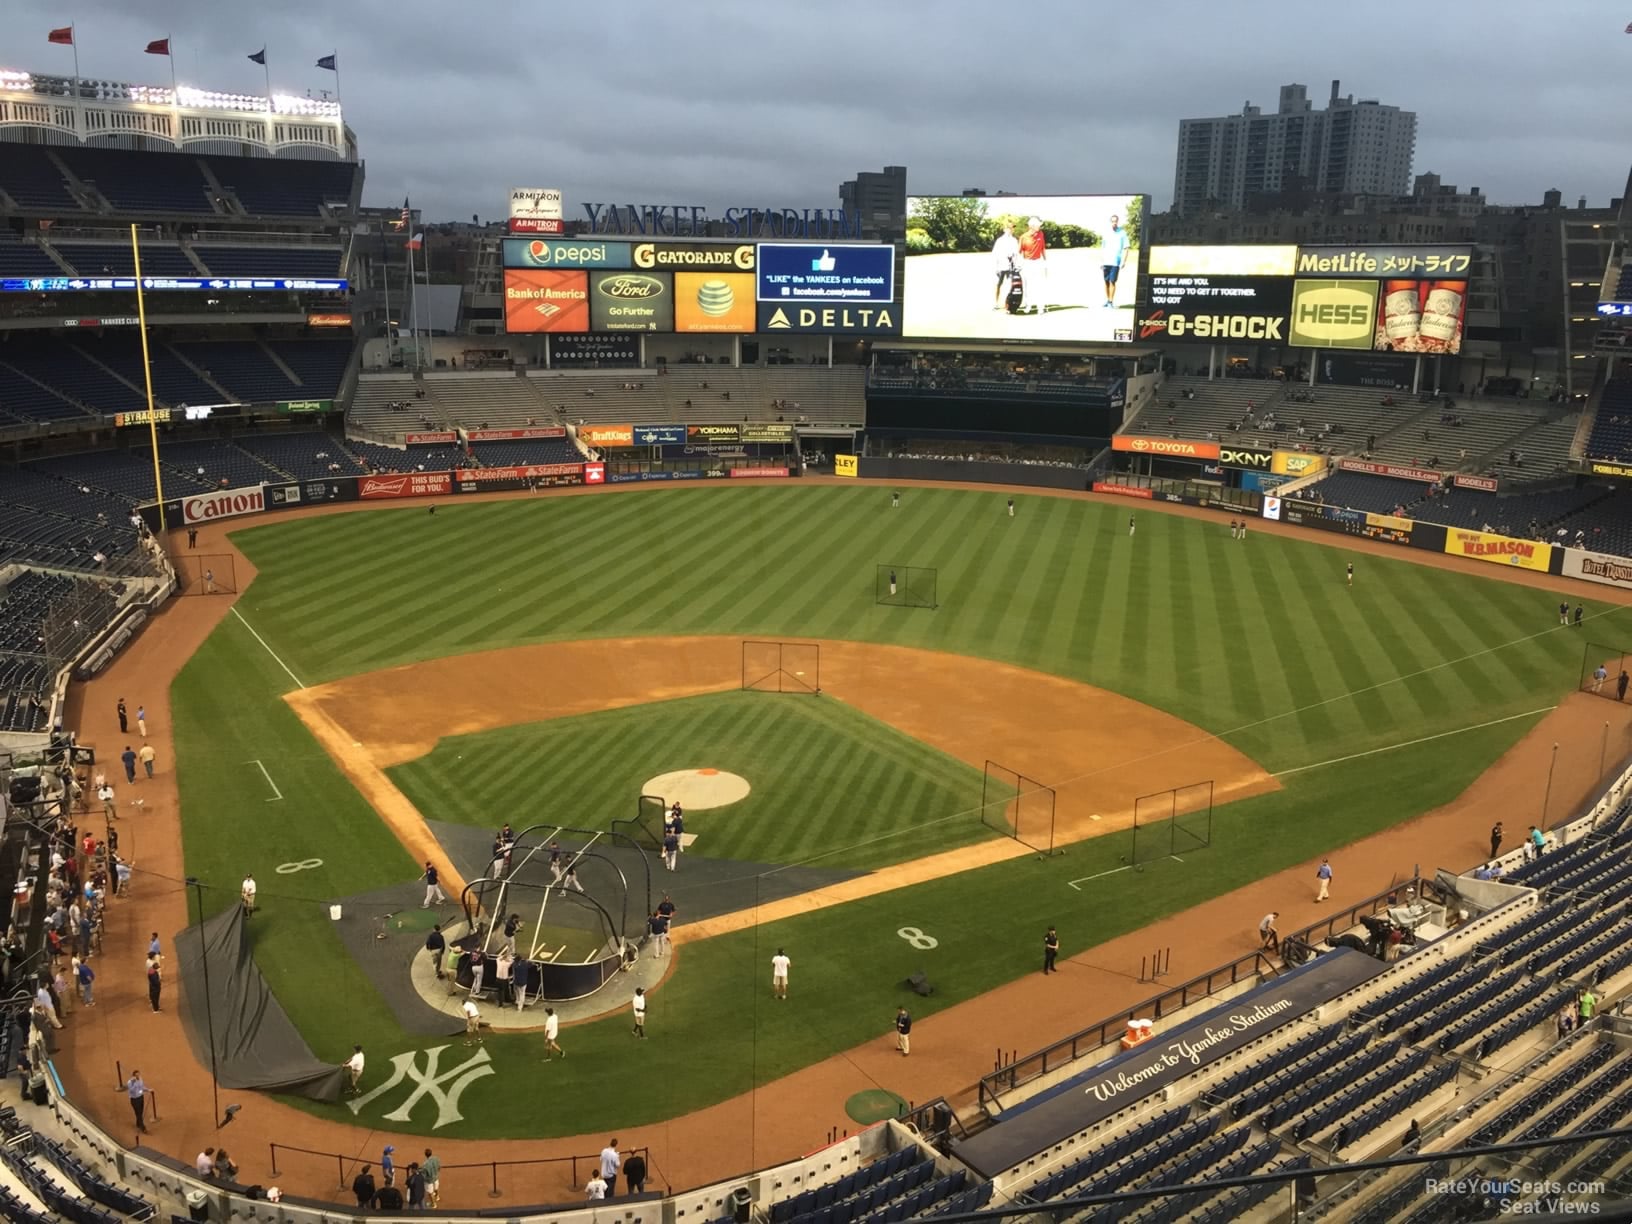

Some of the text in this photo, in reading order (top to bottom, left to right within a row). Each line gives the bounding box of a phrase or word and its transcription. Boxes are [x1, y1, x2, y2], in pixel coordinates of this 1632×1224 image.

[512, 191, 560, 201] ARMITRON
[515, 219, 559, 228] ARMITRON
[581, 202, 862, 239] YANKEE STADIUM
[554, 244, 607, 265] pepsi
[656, 251, 733, 265] GATORADE
[1299, 251, 1377, 273] MetLife
[1382, 254, 1471, 273] メットライフ
[792, 275, 805, 284] the
[806, 275, 841, 285] YANKEES
[842, 277, 852, 285] on
[853, 276, 885, 285] facebook
[1153, 277, 1167, 286] IT'S
[1178, 278, 1193, 286] AND
[611, 278, 652, 297] Ford
[1152, 287, 1167, 296] YOU
[1168, 287, 1186, 296] NEED
[1186, 288, 1197, 296] TO
[1197, 288, 1210, 297] GET
[1211, 288, 1219, 297] IT
[507, 287, 586, 300] Bank of America
[1151, 296, 1182, 304] YOU GOT
[609, 307, 655, 317] Go Further
[1299, 303, 1369, 325] HESS
[126, 317, 140, 325] CLUB
[309, 316, 351, 326] Budweiser
[799, 308, 894, 329] DELTA
[1167, 313, 1284, 340] G-SHOCK
[1360, 377, 1396, 386] THE BOSS
[288, 401, 321, 410] Poland Spring
[592, 431, 632, 441] DraftKings
[700, 426, 739, 435] YOKOHAMA
[695, 444, 745, 453] majorenergy
[1151, 441, 1196, 455] TOYOTA
[1220, 450, 1273, 467] DKNY
[1287, 457, 1309, 471] SAP
[1204, 464, 1225, 475] FedEx
[1343, 460, 1439, 482] MODELL'S MODELLS.com
[411, 475, 451, 484] THIS BUD'S
[1458, 476, 1493, 489] MODELL'S
[365, 480, 403, 491] Budweiser
[411, 485, 444, 493] FOR YOU.
[184, 492, 265, 521] Canon
[1341, 511, 1359, 520] pepsi
[1583, 559, 1606, 575] HOTEL
[1085, 999, 1293, 1101] Welcome to Yankee Stadium
